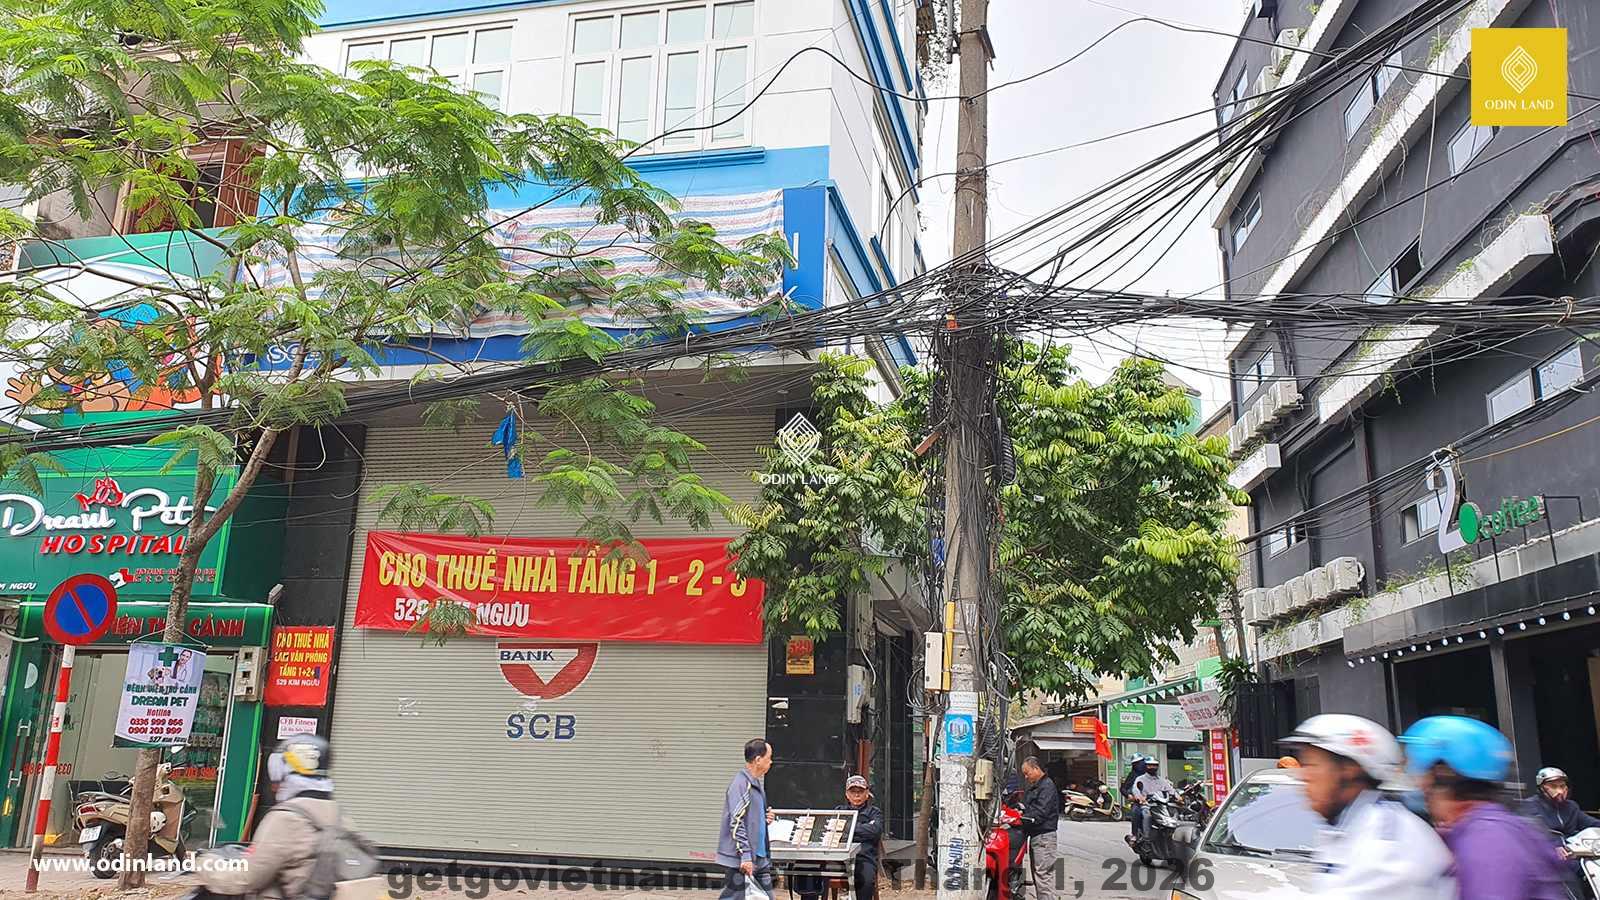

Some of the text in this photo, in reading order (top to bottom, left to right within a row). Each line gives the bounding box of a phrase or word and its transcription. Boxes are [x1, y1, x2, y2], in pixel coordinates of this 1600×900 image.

[40, 534, 190, 555] HOSPITAL
[379, 550, 428, 588] CHO
[436, 548, 498, 591] THUÊ
[503, 549, 558, 593] NHÀ
[568, 545, 637, 595] TẦNG
[646, 559, 658, 595] 1
[686, 559, 705, 597] 2
[476, 601, 530, 627] NGƯU
[500, 650, 554, 661] BANK
[131, 695, 189, 707] DREAM PET
[506, 713, 577, 740] SCB
